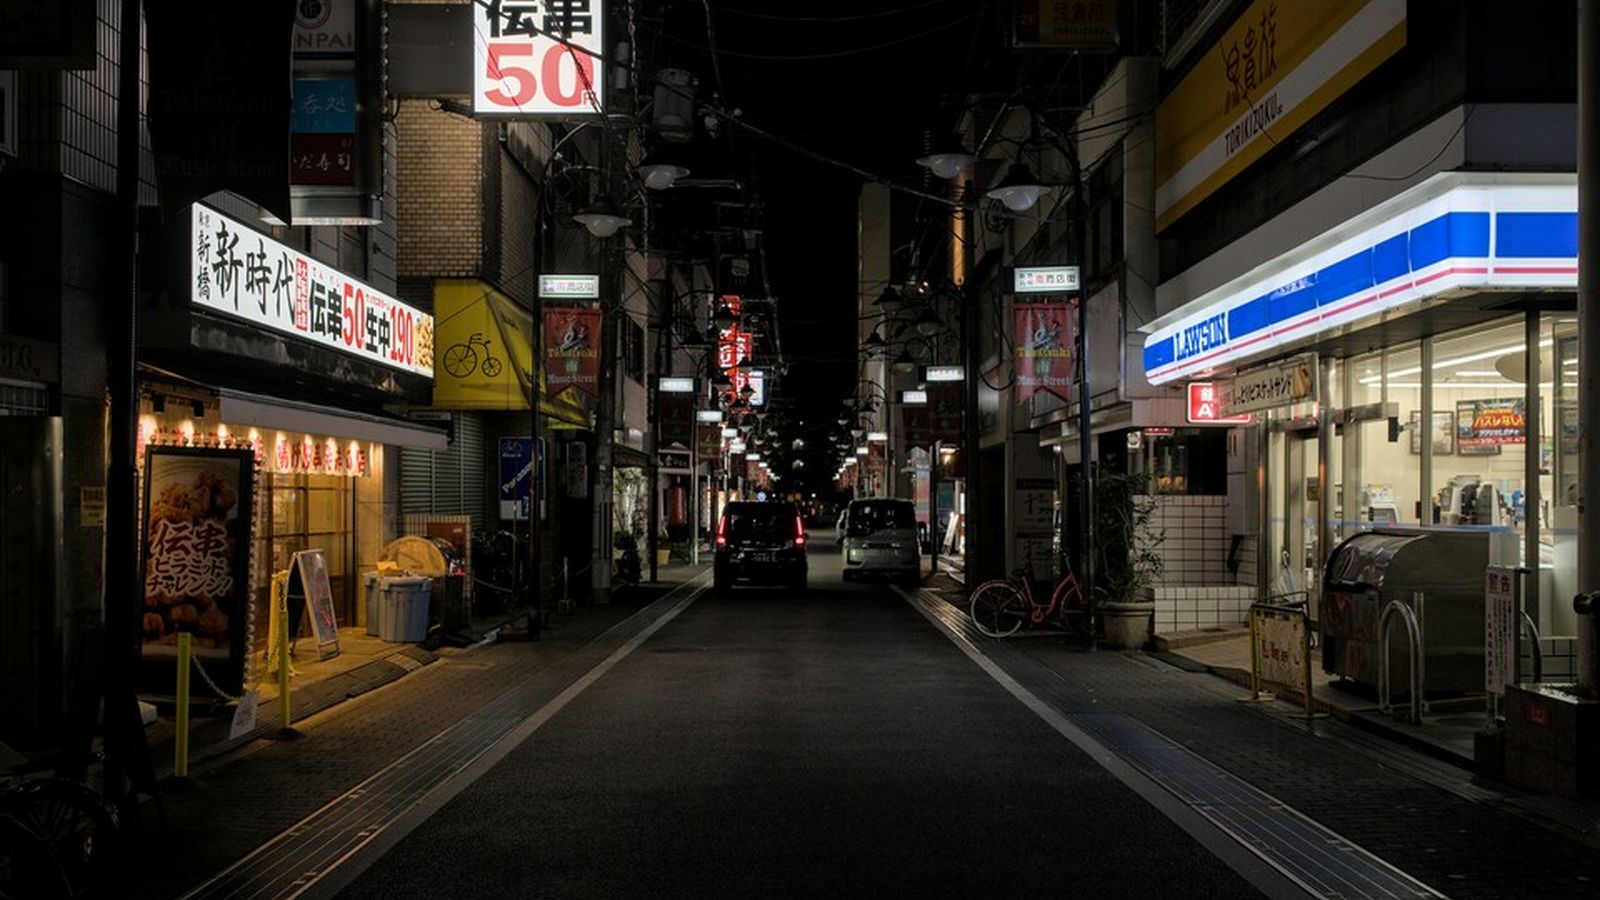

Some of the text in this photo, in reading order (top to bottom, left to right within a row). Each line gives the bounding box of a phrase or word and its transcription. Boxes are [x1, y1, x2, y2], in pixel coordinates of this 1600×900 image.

[297, 32, 352, 48] NPAI
[487, 0, 593, 38] 伝串
[196, 230, 211, 301] 新橋
[212, 220, 296, 326] 新時代
[1176, 311, 1227, 361] LAWSON
[152, 520, 226, 560] 伝串
